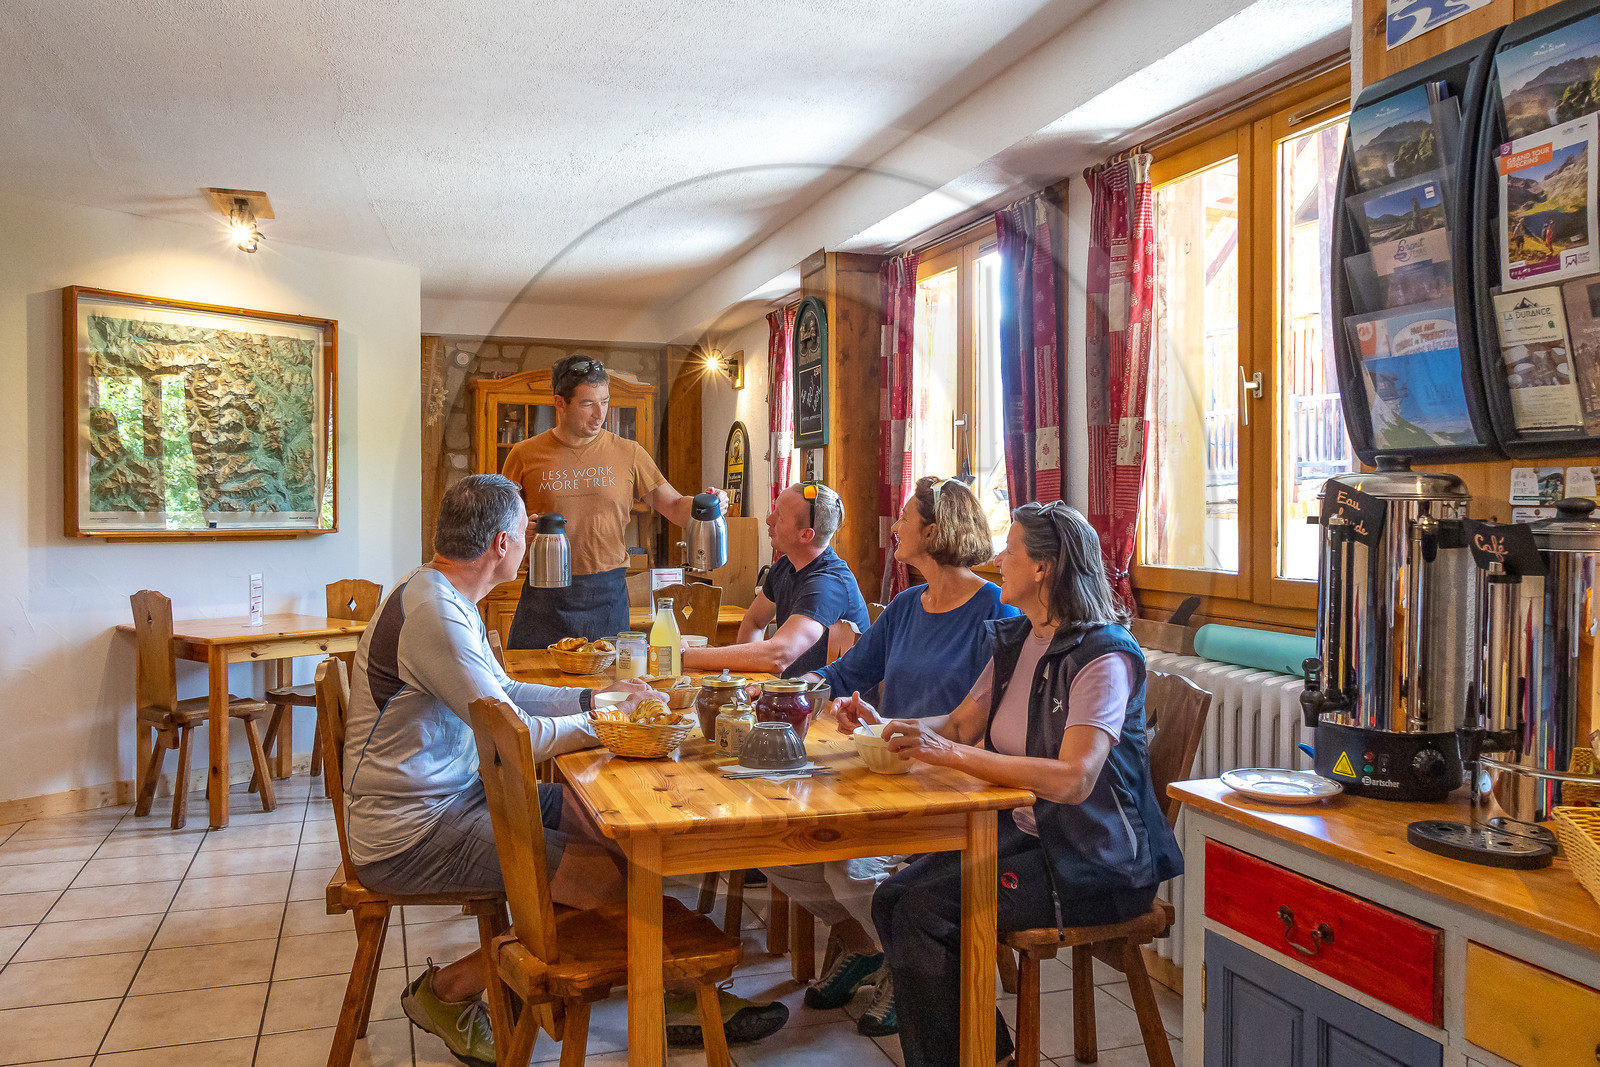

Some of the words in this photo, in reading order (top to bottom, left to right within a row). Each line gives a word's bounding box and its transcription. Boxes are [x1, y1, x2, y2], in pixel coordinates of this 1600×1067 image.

[1507, 152, 1531, 166] GRAND
[1532, 146, 1550, 157] TOUR
[1503, 312, 1513, 321] LA
[541, 468, 568, 481] LESS
[572, 465, 614, 478] WORK
[538, 478, 580, 492] MORE
[583, 476, 616, 488] TREK
[1336, 489, 1361, 511] Eau
[1474, 533, 1509, 562] Café
[1361, 775, 1400, 788] Bartscher
